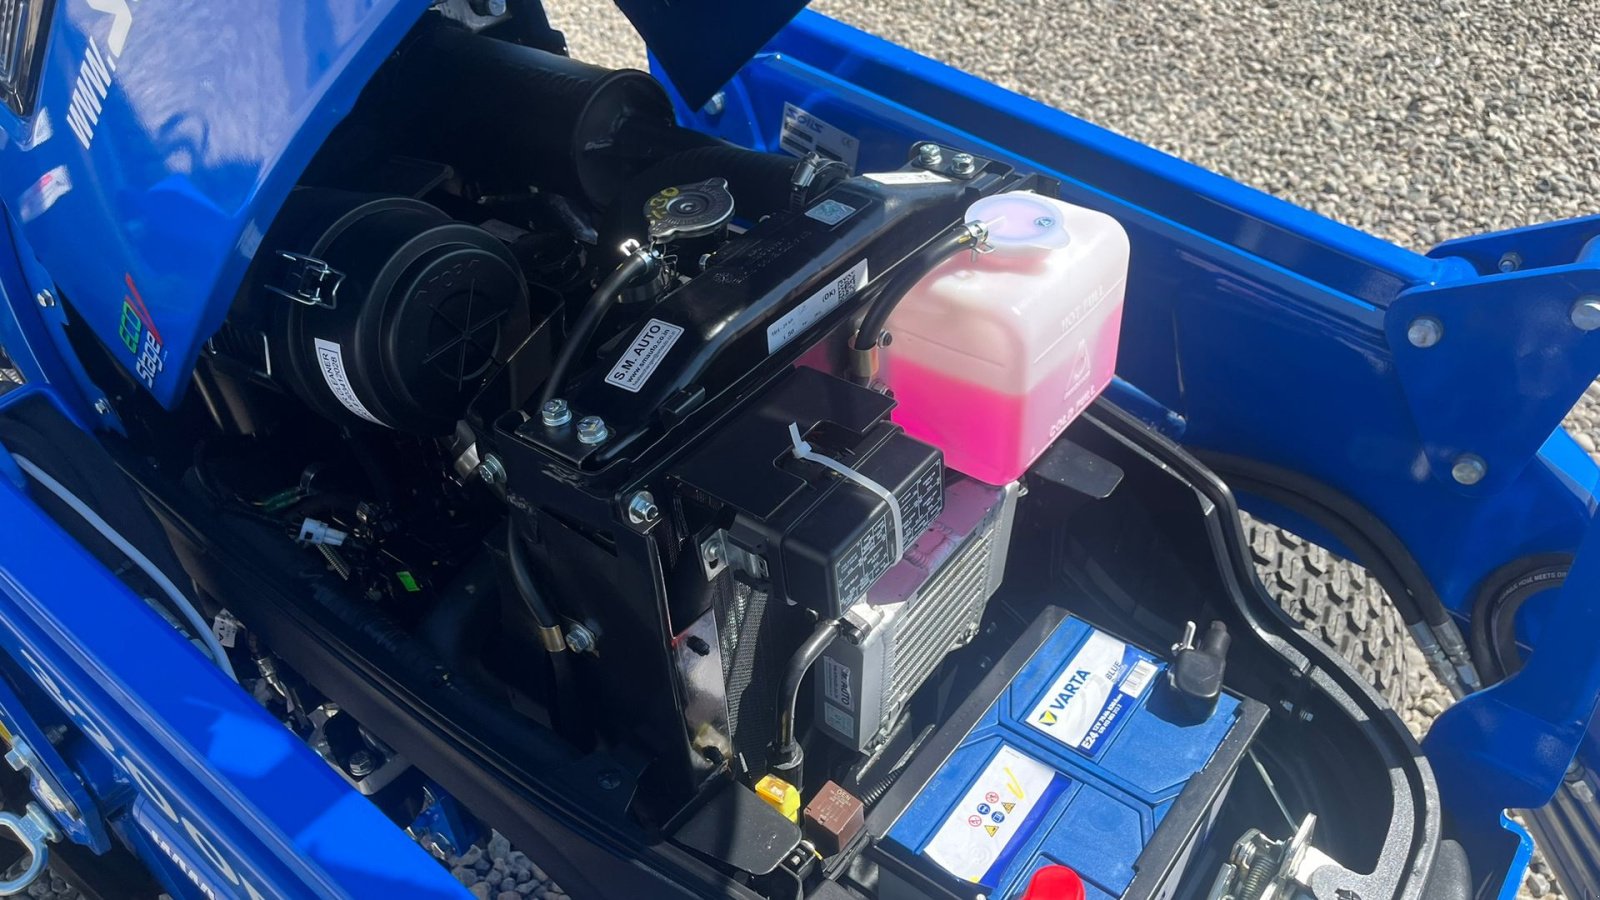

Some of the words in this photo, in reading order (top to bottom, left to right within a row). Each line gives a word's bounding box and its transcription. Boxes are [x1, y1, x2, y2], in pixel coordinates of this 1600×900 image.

[136, 330, 162, 389] Stage
[613, 359, 637, 381] S.M.
[633, 324, 661, 357] AUTO
[1049, 668, 1092, 711] VARTA
[1105, 660, 1121, 680] BLUE
[20, 648, 265, 900] 3200
